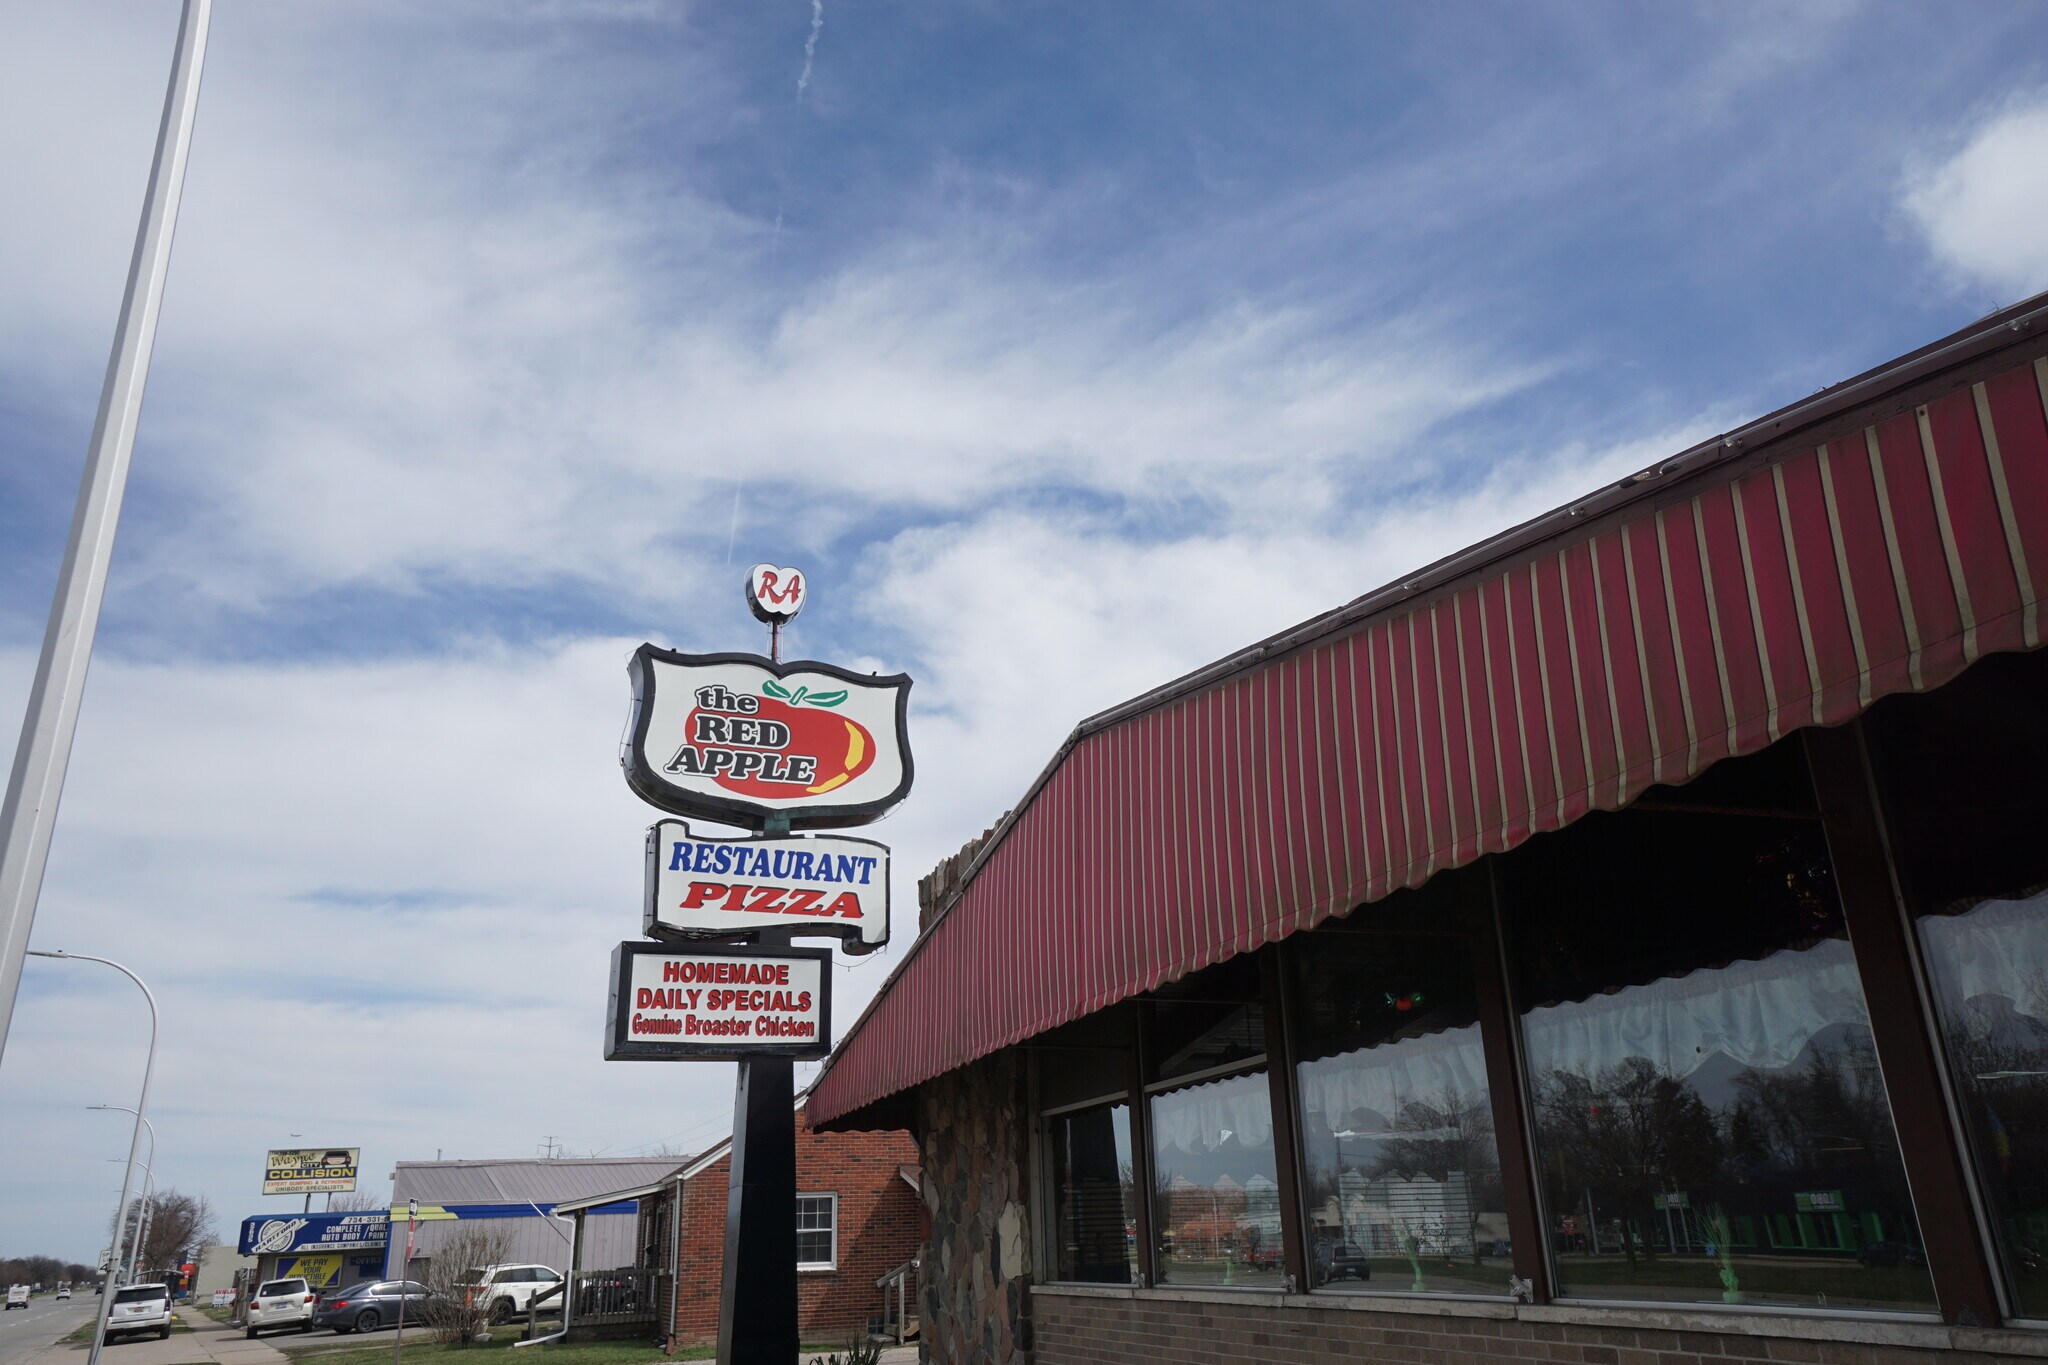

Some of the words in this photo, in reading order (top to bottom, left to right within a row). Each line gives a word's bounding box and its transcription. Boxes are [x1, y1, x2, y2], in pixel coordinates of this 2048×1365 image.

[758, 571, 802, 604] RA
[697, 686, 758, 713] the
[696, 715, 789, 748] RED
[665, 746, 817, 784] APPLE
[669, 842, 877, 884] RESTAURANT
[679, 881, 865, 918] PIZZA
[663, 961, 790, 985] HOMEMADE
[637, 988, 702, 1010] DAILY
[707, 989, 812, 1012] SPECIALS
[632, 1012, 683, 1036] Genuine
[685, 1014, 752, 1036] Broaster
[755, 1015, 815, 1037] Chicken
[271, 1152, 317, 1168] Wayne
[269, 1168, 354, 1179] COLLISION
[255, 1220, 297, 1252] HARTFORD
[321, 1233, 340, 1242] AUTO
[342, 1232, 361, 1241] BODY
[326, 1225, 362, 1234] COMPLETE
[370, 1224, 388, 1232] QUAL
[301, 1259, 311, 1267] WE
[313, 1258, 329, 1266] PAY
